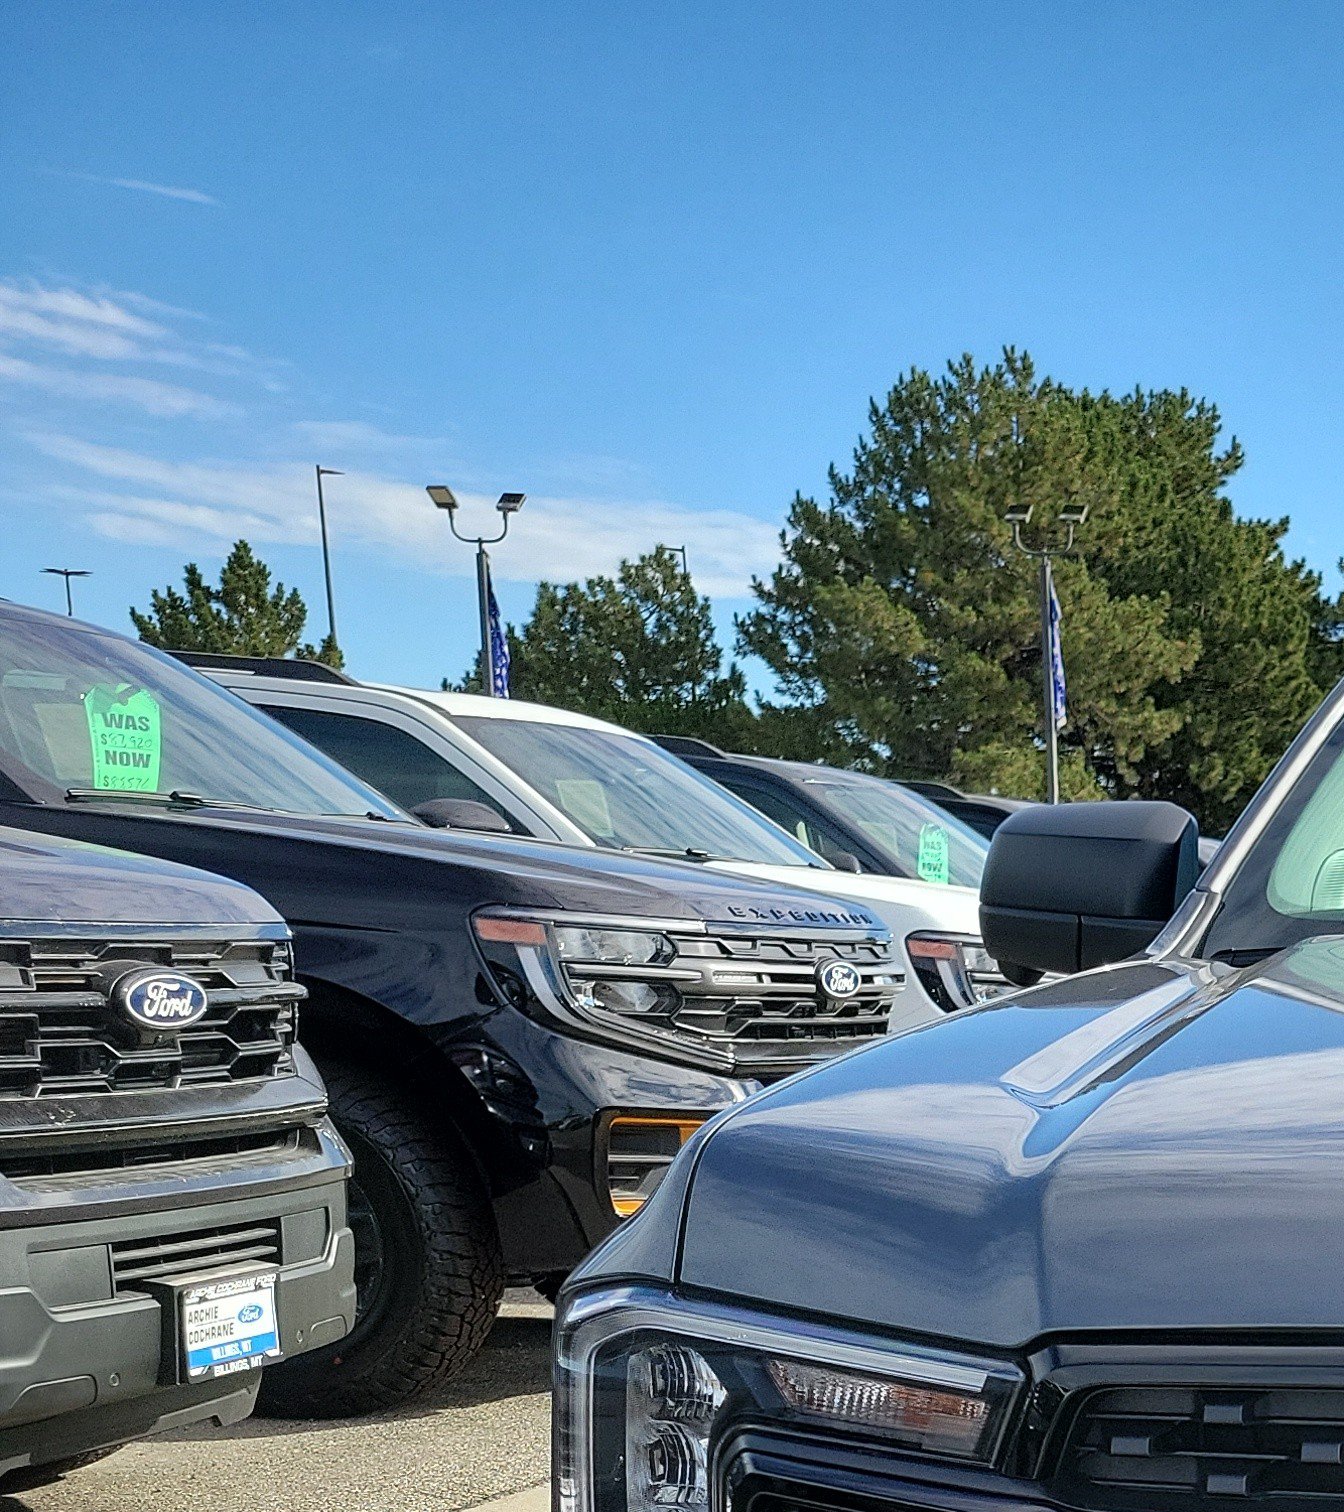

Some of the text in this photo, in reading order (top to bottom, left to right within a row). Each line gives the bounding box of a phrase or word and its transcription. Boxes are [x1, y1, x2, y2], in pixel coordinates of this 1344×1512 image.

[101, 712, 151, 732] WAS
[104, 749, 152, 769] NOW
[727, 905, 873, 926] EXPEDITION
[829, 966, 855, 991] Ford
[143, 981, 194, 1018] Ford
[188, 1306, 219, 1325] ARCHIE
[241, 1305, 261, 1323] Ford
[188, 1322, 235, 1345] COCHRANE
